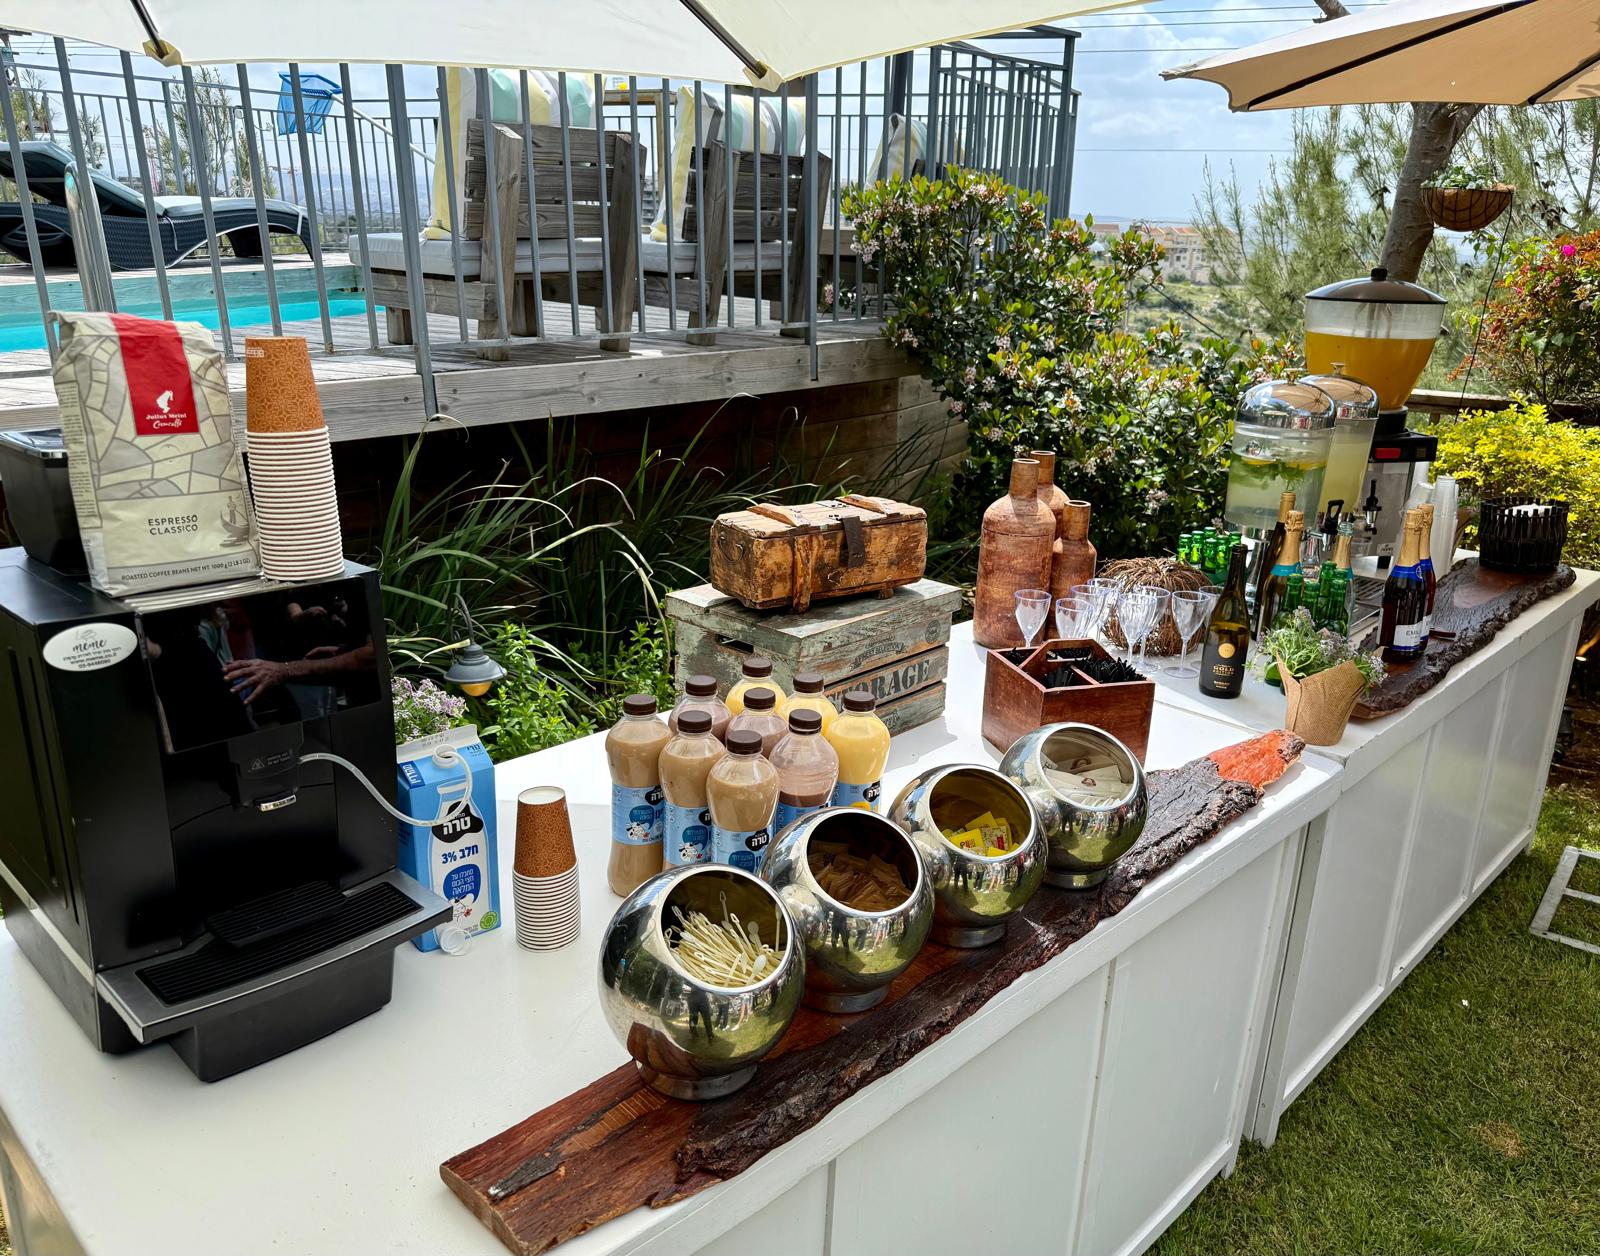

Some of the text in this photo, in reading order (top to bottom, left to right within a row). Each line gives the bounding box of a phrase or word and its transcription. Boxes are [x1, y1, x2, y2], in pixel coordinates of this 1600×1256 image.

[147, 514, 198, 527] ESPRESSO
[149, 524, 199, 536] CLASSICO
[121, 572, 148, 581] ROASTED
[149, 570, 171, 578] COFFEE
[171, 567, 190, 576] BEANS
[190, 565, 201, 574] NET
[442, 816, 471, 835] טרה
[751, 834, 768, 847] טרה
[441, 844, 479, 864] חלב 3%
